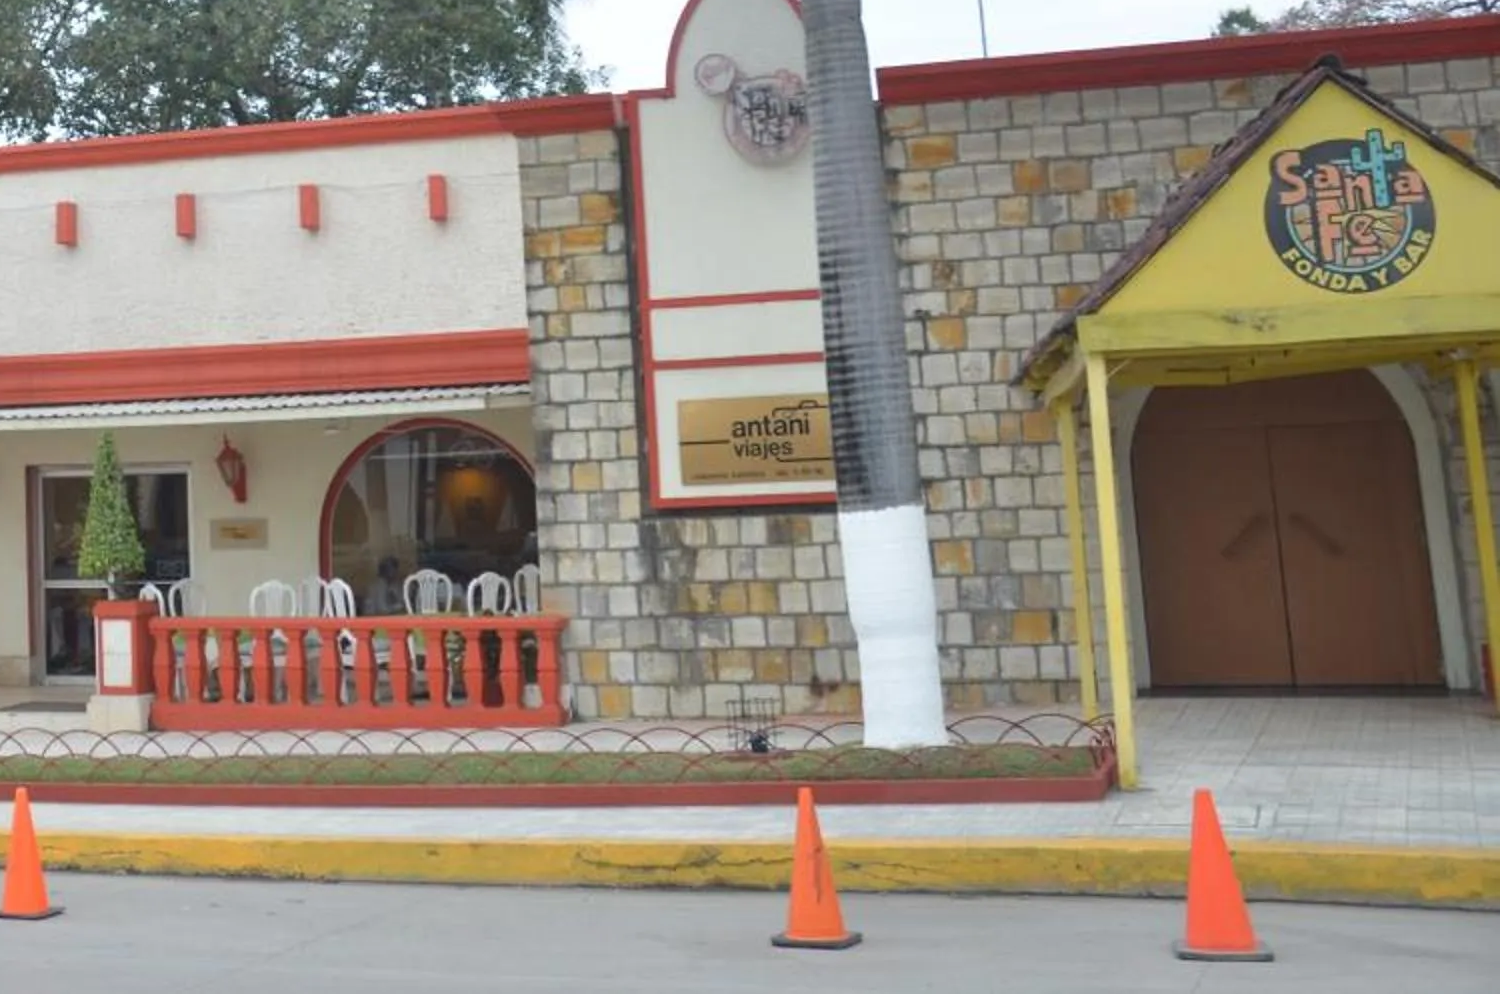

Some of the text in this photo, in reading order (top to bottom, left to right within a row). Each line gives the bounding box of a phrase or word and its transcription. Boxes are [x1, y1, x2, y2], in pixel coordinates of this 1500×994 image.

[1274, 129, 1426, 208] Santa
[1281, 229, 1432, 292] FONDA Y BAR
[734, 439, 794, 460] viajes
